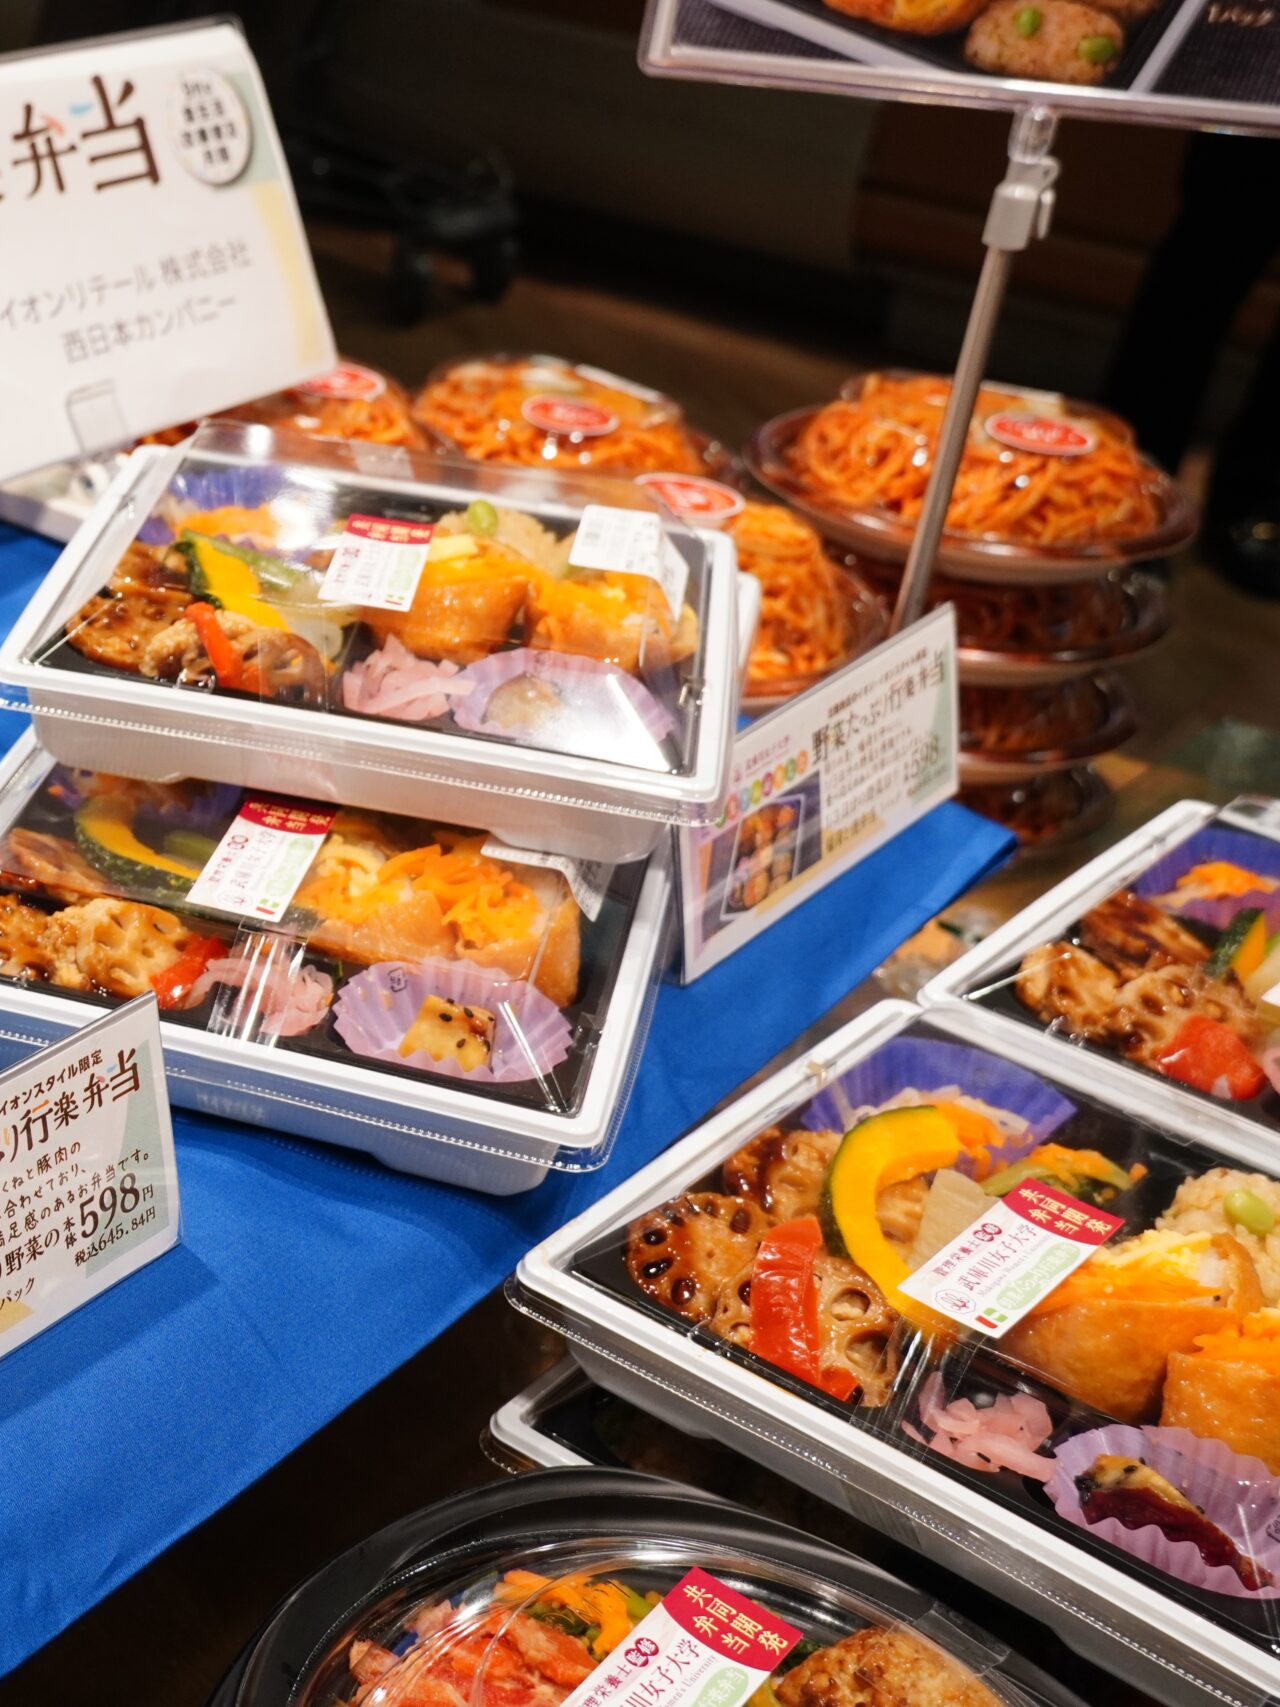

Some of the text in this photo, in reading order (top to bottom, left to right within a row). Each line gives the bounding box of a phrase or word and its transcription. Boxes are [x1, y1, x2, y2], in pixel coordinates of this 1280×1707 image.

[60, 294, 238, 364] 西日本カンパニー
[1019, 1188, 1112, 1235] 共同開発
[1028, 1209, 1079, 1234] 弁当
[958, 1224, 1037, 1292] 武庫川女子大学
[683, 1584, 788, 1655] 共同開発
[692, 1615, 750, 1654] 弁当
[619, 1638, 700, 1707] 川女子大学
